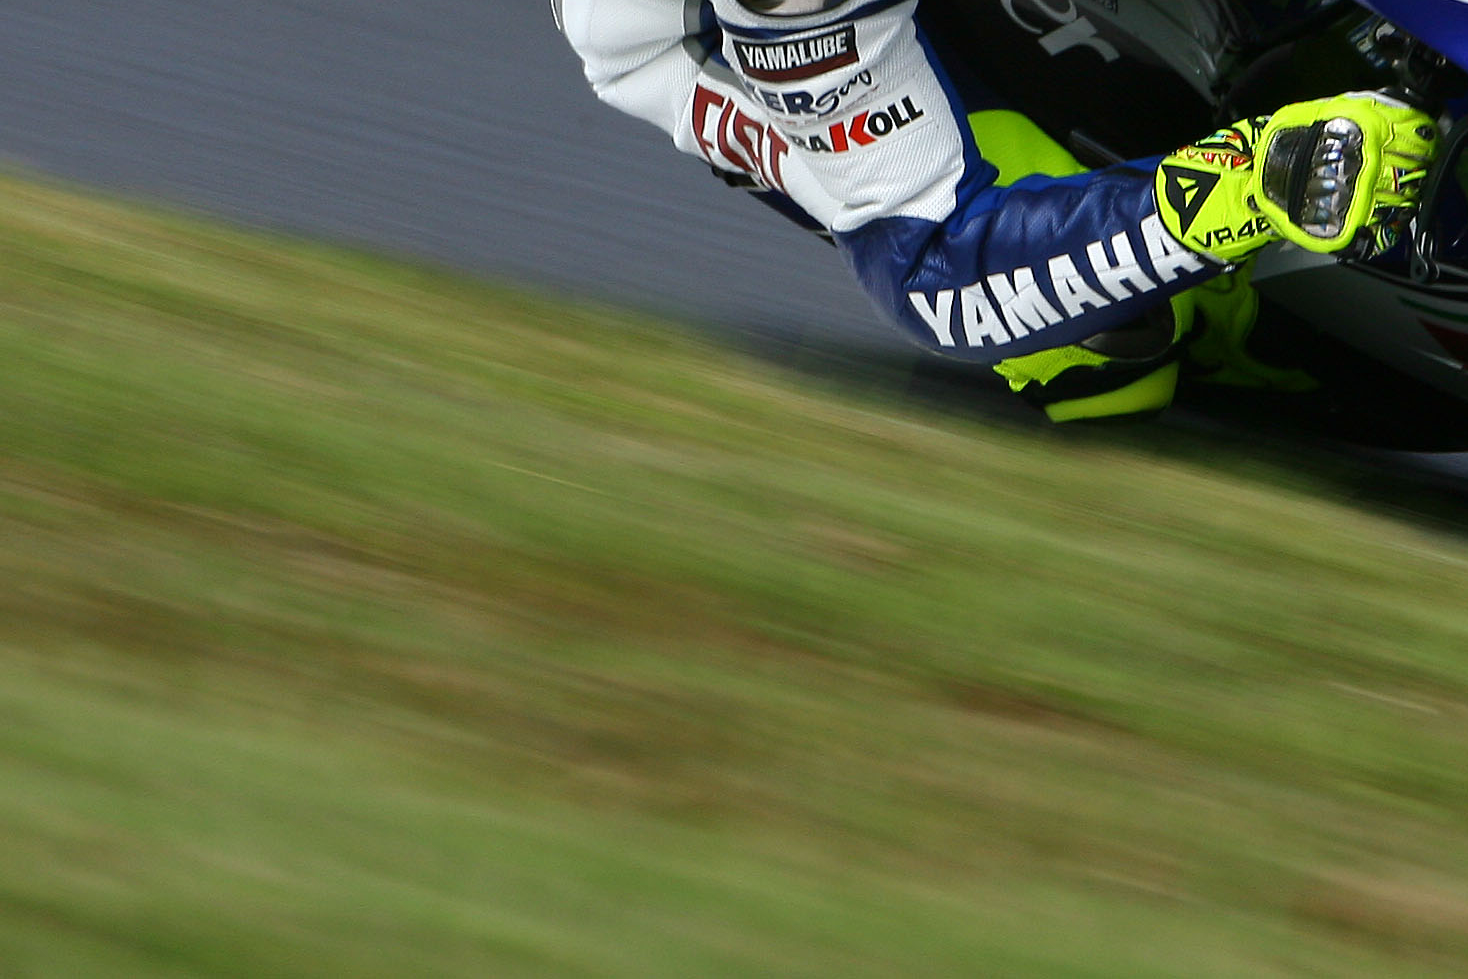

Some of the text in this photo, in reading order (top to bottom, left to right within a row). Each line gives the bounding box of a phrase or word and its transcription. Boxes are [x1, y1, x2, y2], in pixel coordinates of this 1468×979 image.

[741, 31, 849, 70] YAMALUBE
[691, 82, 790, 193] FIAT
[1192, 216, 1271, 248] VR46
[907, 211, 1207, 350] YAMAHA
